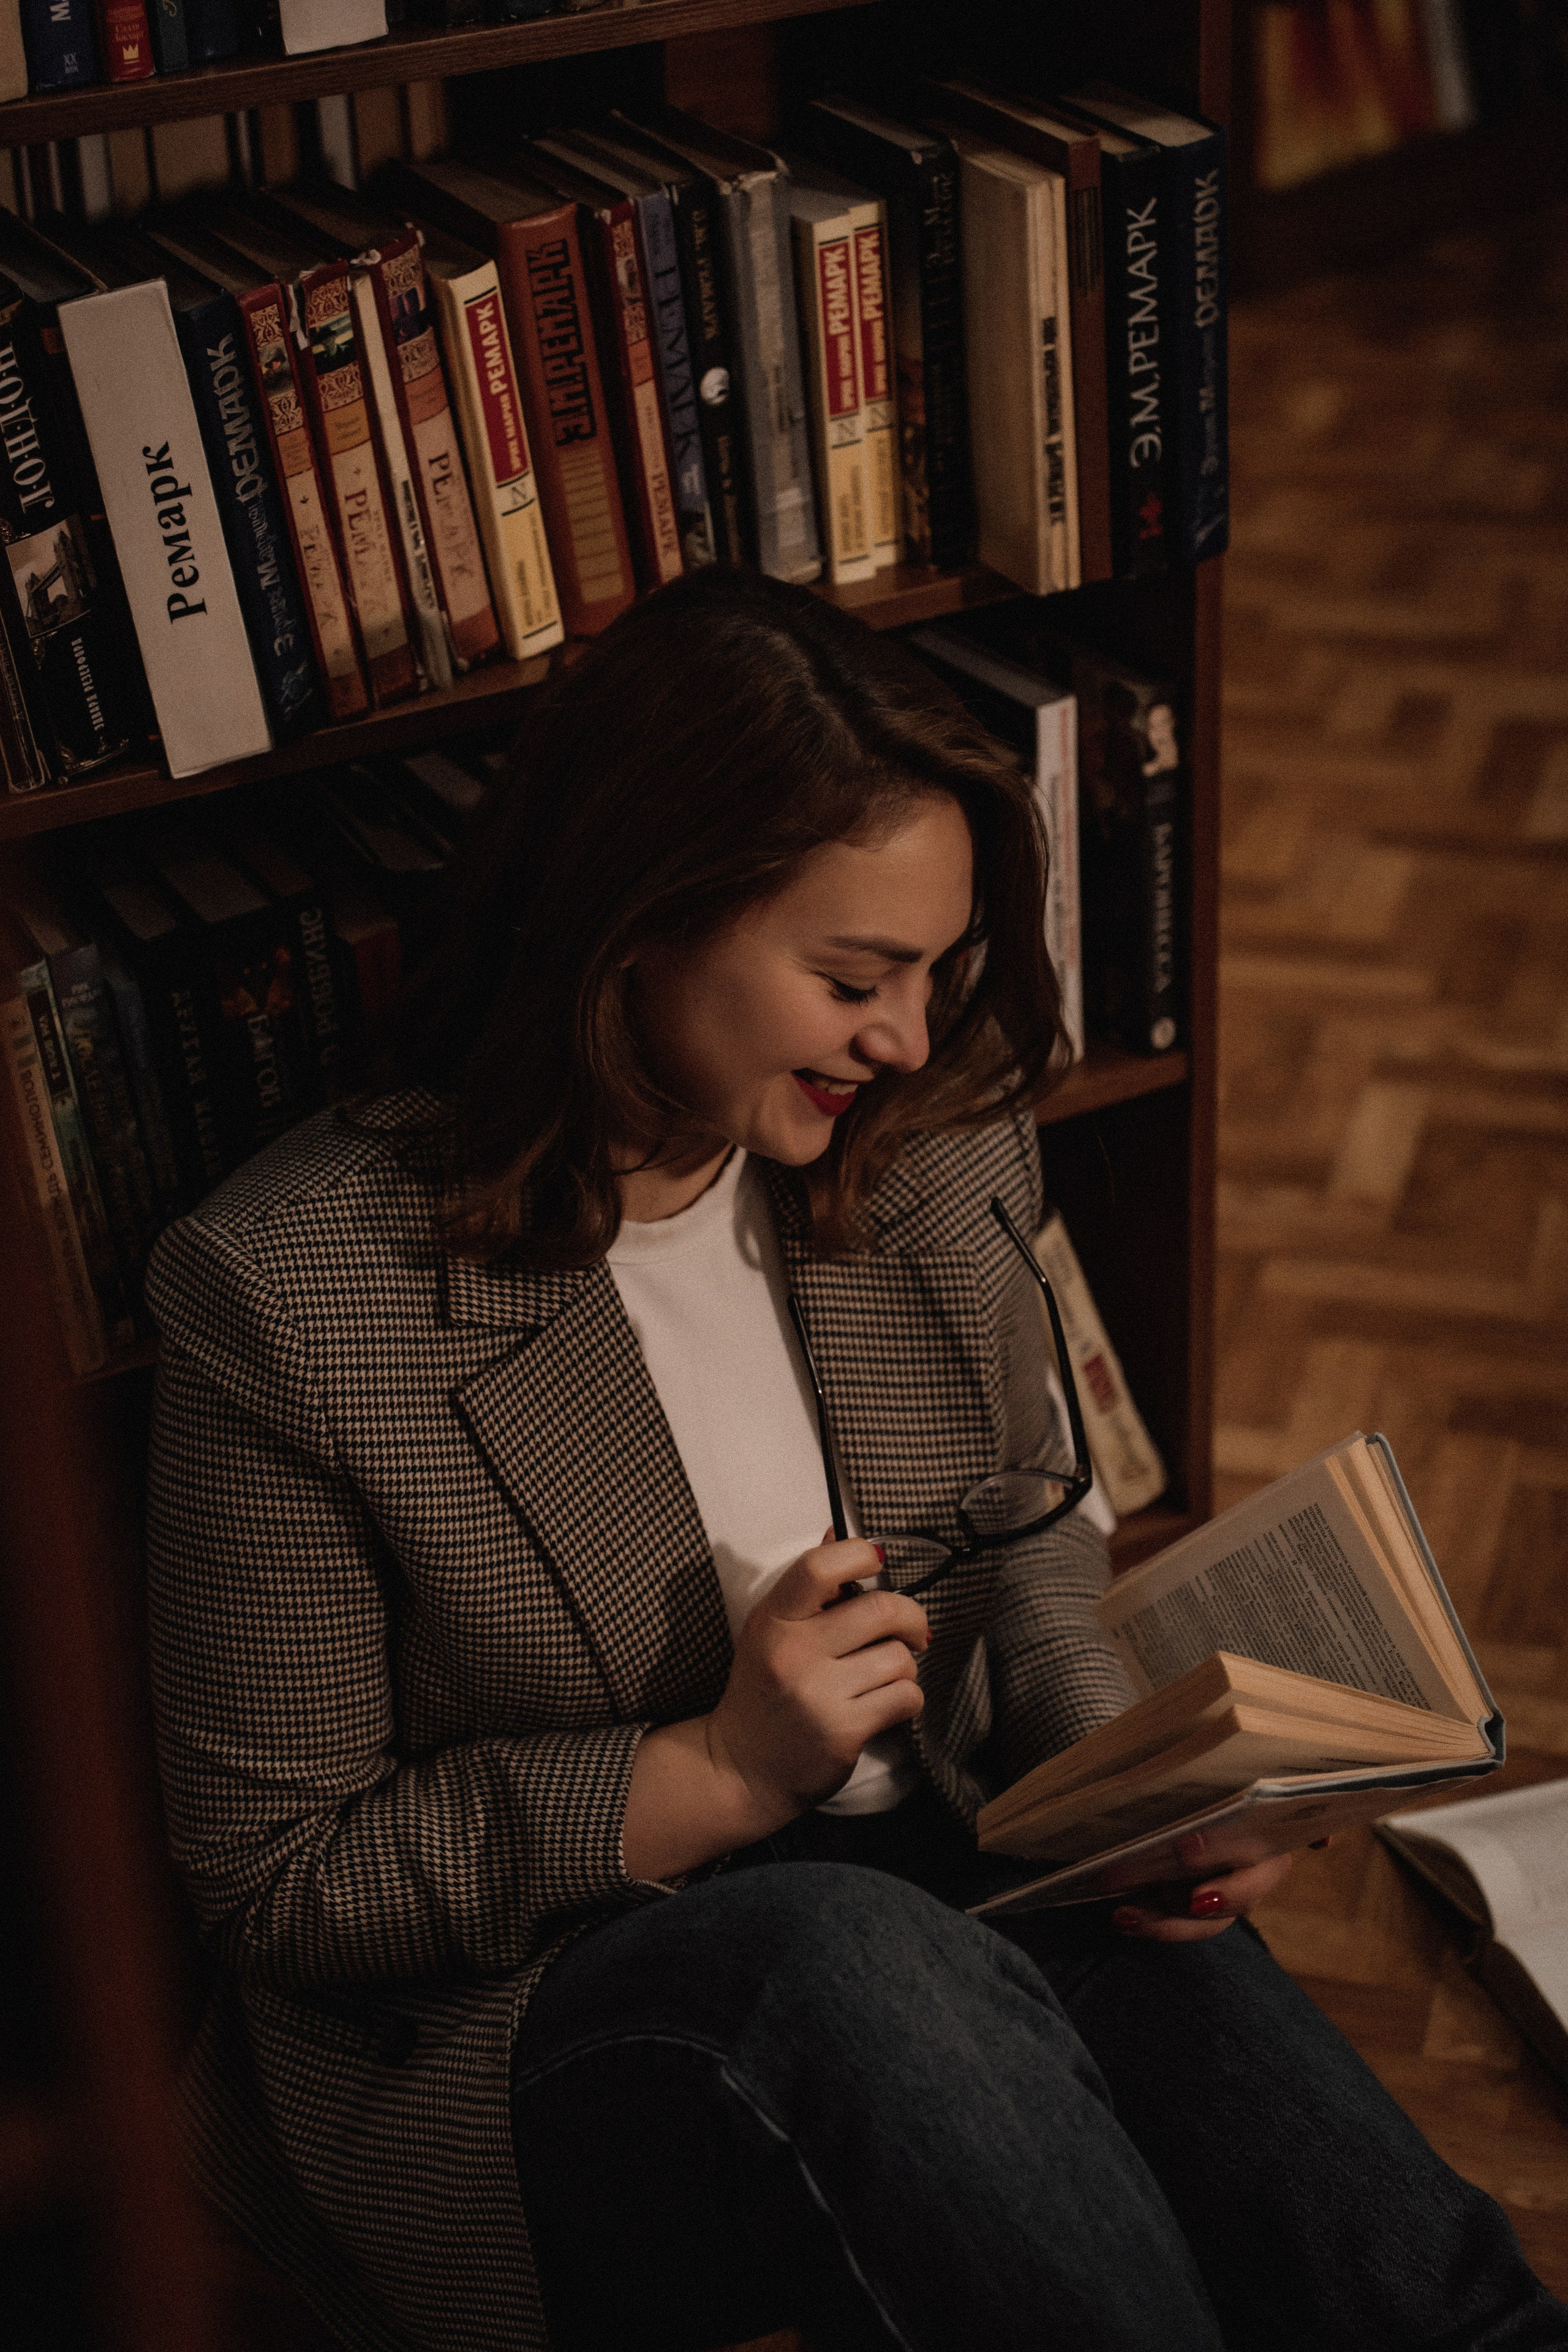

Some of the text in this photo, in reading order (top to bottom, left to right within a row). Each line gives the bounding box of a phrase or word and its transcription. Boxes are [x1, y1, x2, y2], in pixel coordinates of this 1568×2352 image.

[824, 246, 850, 336] РЕМАРК
[858, 231, 883, 320] РЕМАРК
[477, 301, 508, 396] РЕМАРК
[654, 266, 699, 461] РЕМАРК
[142, 441, 207, 624] Ремарк
[19, 1069, 54, 1170] СЕМИНОЛОВ
